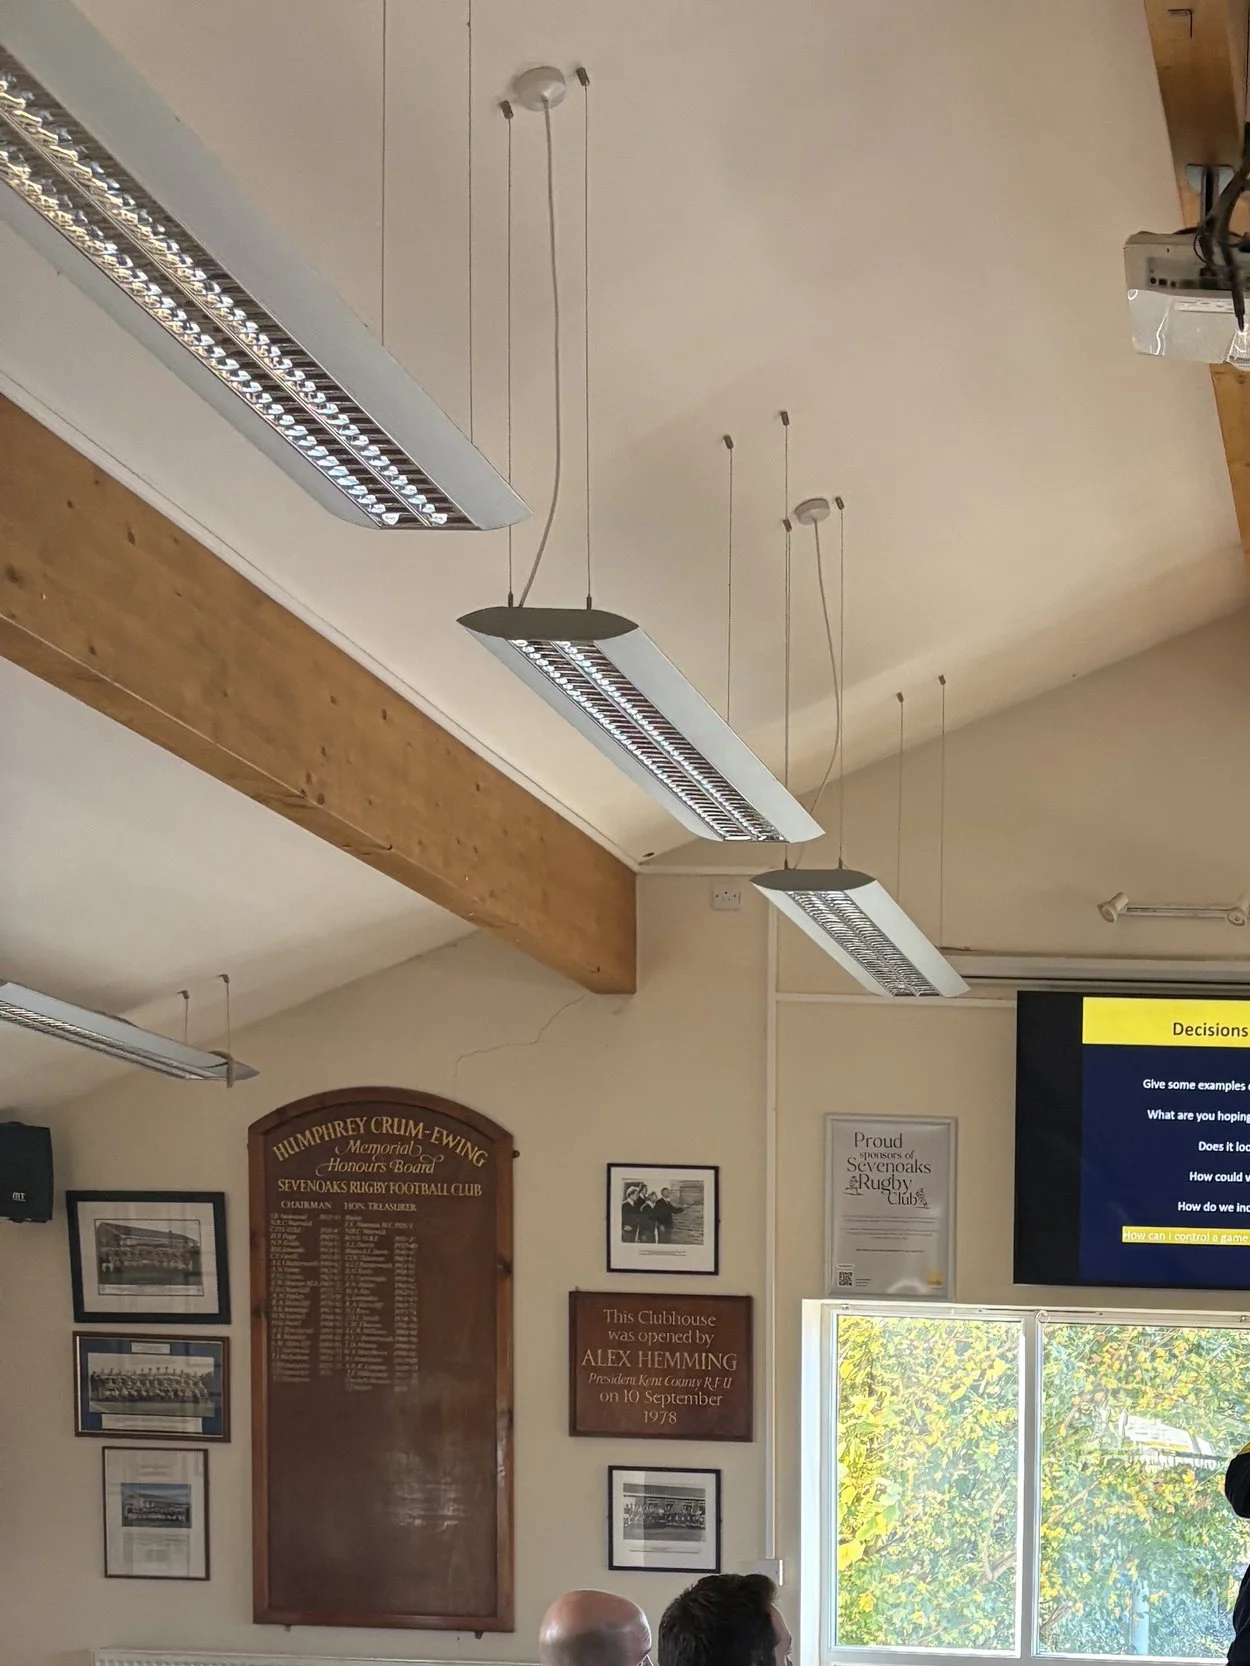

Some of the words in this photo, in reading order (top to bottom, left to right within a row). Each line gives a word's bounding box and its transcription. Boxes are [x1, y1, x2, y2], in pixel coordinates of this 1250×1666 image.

[1173, 1022, 1248, 1037] Decisions
[1143, 1079, 1165, 1090] Give
[1168, 1082, 1196, 1091] some
[1198, 1080, 1245, 1093] examples
[1147, 1109, 1175, 1121] What
[1177, 1112, 1194, 1121] are
[1196, 1112, 1215, 1123] you
[273, 1117, 367, 1161] HUMPHREY
[371, 1116, 488, 1168] CRUM-EWING
[854, 1131, 902, 1149] Proud
[1198, 1141, 1224, 1152] Does
[1226, 1141, 1234, 1152] it
[337, 1140, 421, 1158] Memorial
[859, 1151, 902, 1161] sponsors
[904, 1149, 916, 1160] of
[318, 1157, 387, 1175] Honours
[390, 1155, 441, 1174] Board
[847, 1157, 931, 1174] Sevenoaks
[859, 1173, 912, 1195] Rugby
[1189, 1171, 1213, 1182] How
[1215, 1171, 1243, 1182] could
[278, 1179, 347, 1194] SEVENOAKS
[350, 1181, 388, 1195] RUGBY
[389, 1182, 449, 1196] FOOTBALL
[451, 1183, 482, 1197] CLUB
[281, 1200, 332, 1210] CHAIRMAN
[368, 1202, 417, 1211] TREASURER
[887, 1191, 918, 1206] Club
[1177, 1201, 1201, 1212] How
[1203, 1201, 1217, 1212] do
[1219, 1204, 1235, 1213] we
[1123, 1230, 1145, 1240] How
[1148, 1231, 1165, 1241] can
[1174, 1231, 1210, 1242] control
[1212, 1234, 1218, 1242] a
[1221, 1234, 1249, 1245] game
[603, 1309, 635, 1324] This
[638, 1310, 717, 1327] Clubhouse
[608, 1331, 635, 1342] was
[638, 1329, 692, 1346] opened
[696, 1330, 715, 1349] by
[582, 1349, 632, 1368] ALEX
[638, 1351, 738, 1371] HEMMING
[588, 1372, 636, 1387] President
[639, 1374, 662, 1387] Kent
[664, 1376, 701, 1391] County
[600, 1391, 618, 1403] on
[624, 1389, 640, 1403] 10
[643, 1390, 723, 1408] September
[643, 1410, 678, 1425] 1978
